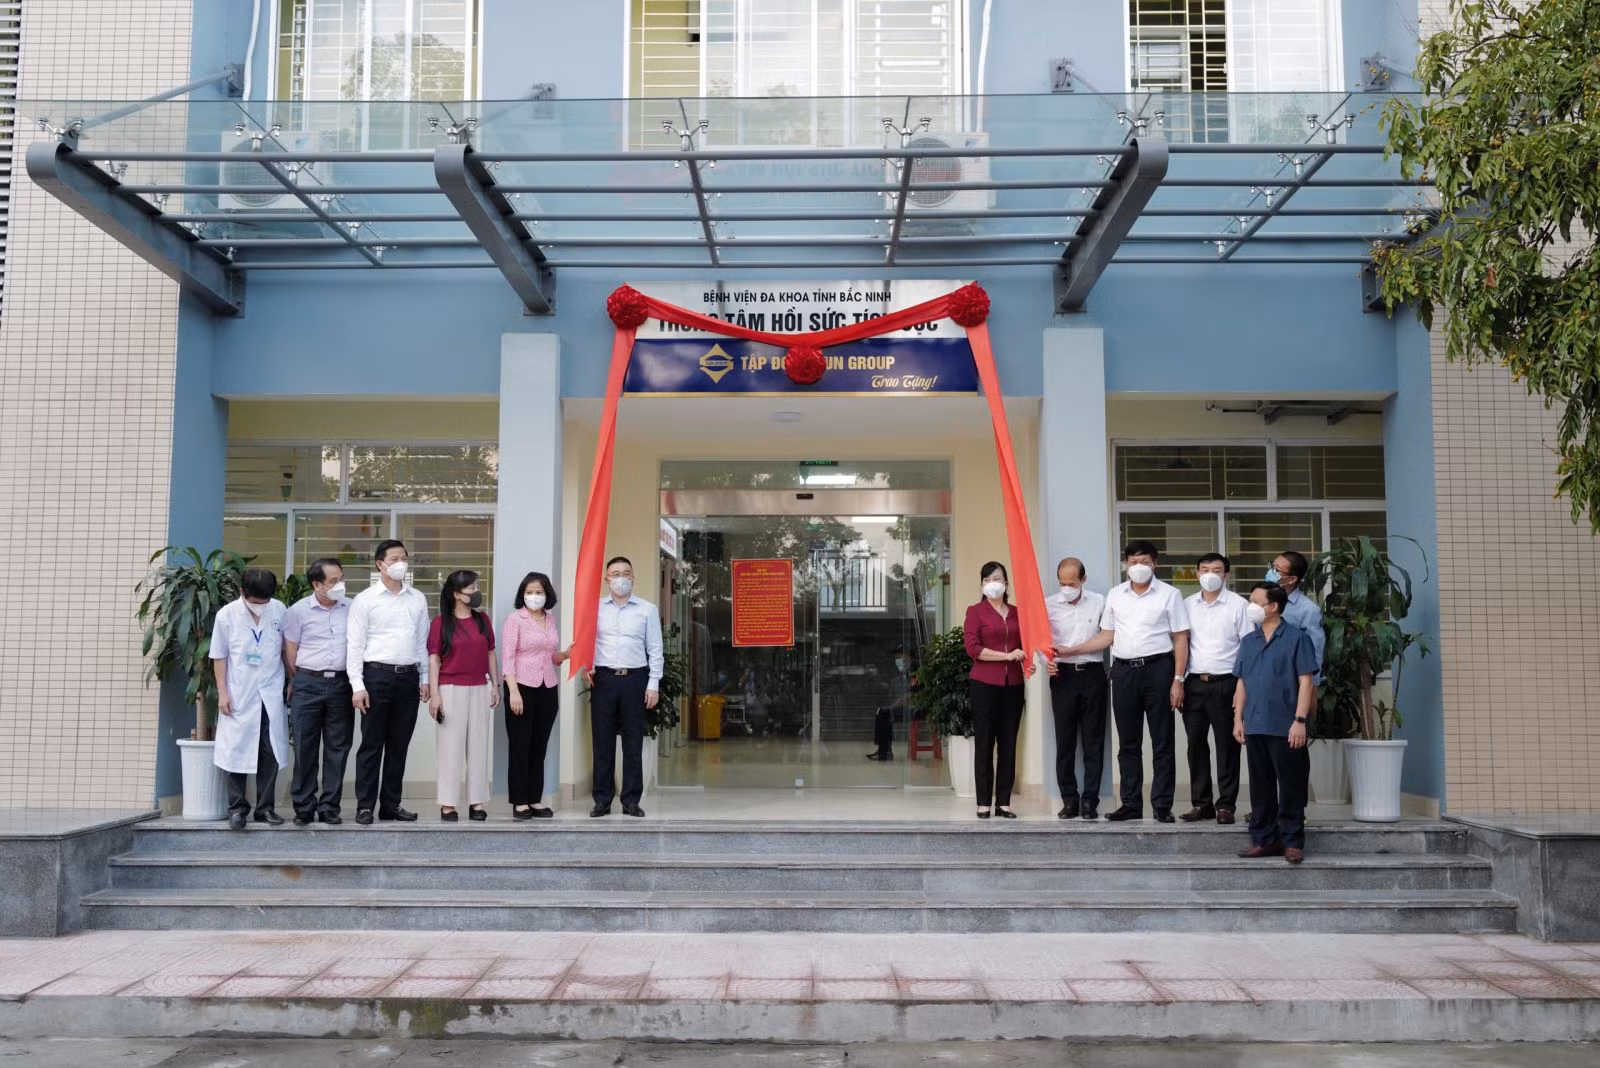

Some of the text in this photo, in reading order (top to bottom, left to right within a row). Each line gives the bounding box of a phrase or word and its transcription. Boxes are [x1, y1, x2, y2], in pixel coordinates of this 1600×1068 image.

[704, 287, 891, 305] BỆNH VIỆN ĐA KHOA TỈNH BẮC NINH
[725, 309, 765, 332] TÂM
[771, 307, 802, 332] HỒI
[809, 307, 846, 332] SỨC
[740, 354, 767, 373] TẬP
[824, 356, 844, 370] UN
[848, 356, 895, 370] GROUP
[871, 375, 899, 388] Trao
